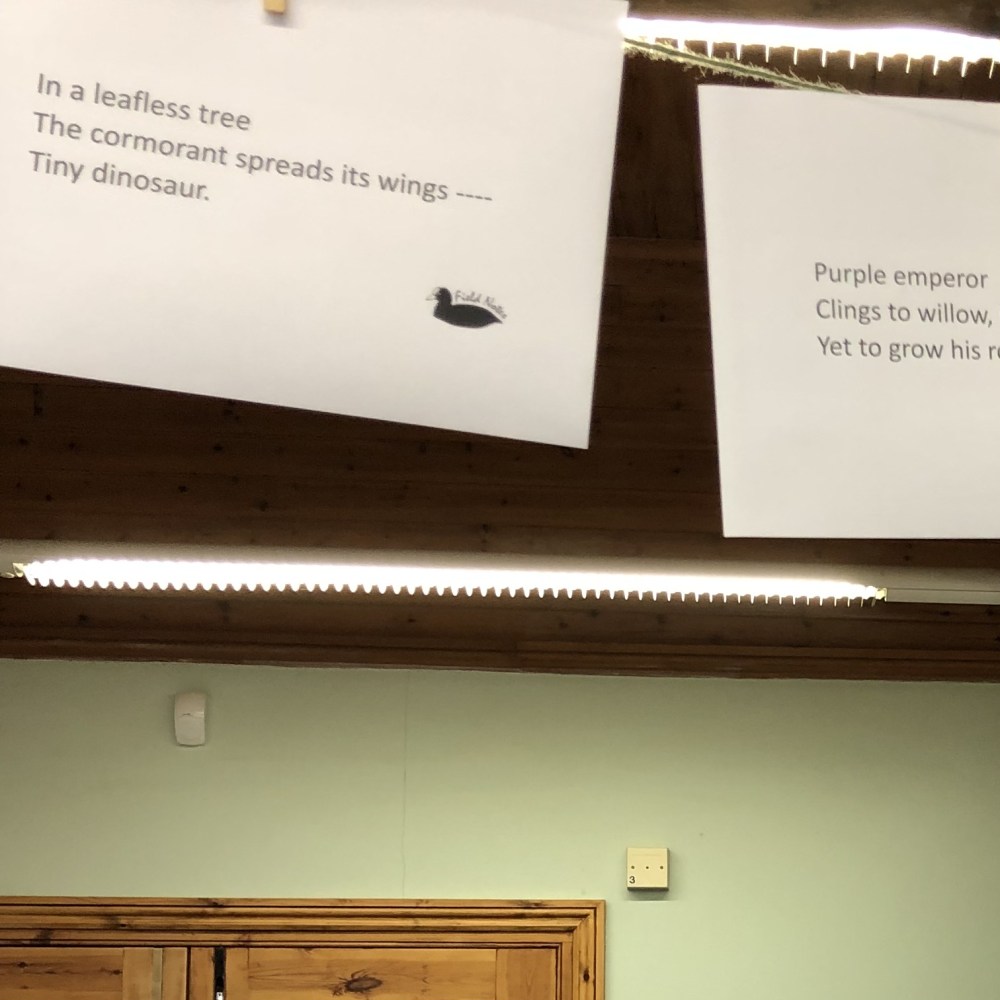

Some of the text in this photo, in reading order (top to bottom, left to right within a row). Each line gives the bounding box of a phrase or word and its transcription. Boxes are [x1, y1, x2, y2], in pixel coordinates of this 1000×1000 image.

[38, 73, 251, 130] In a leafless tree
[34, 112, 82, 139] The
[91, 128, 227, 165] cormorant
[236, 153, 333, 182] spreads
[342, 165, 369, 187] its
[379, 174, 448, 202] wings
[29, 151, 209, 200] Tiny dinosaur.
[815, 262, 988, 291] Purple emperor
[817, 299, 881, 325] Clings
[888, 304, 910, 321] to
[918, 303, 992, 327] willow,
[817, 336, 852, 356] Yet
[859, 339, 881, 357] to
[890, 343, 943, 362] grow
[951, 339, 980, 360] his
[629, 875, 636, 884] 3
